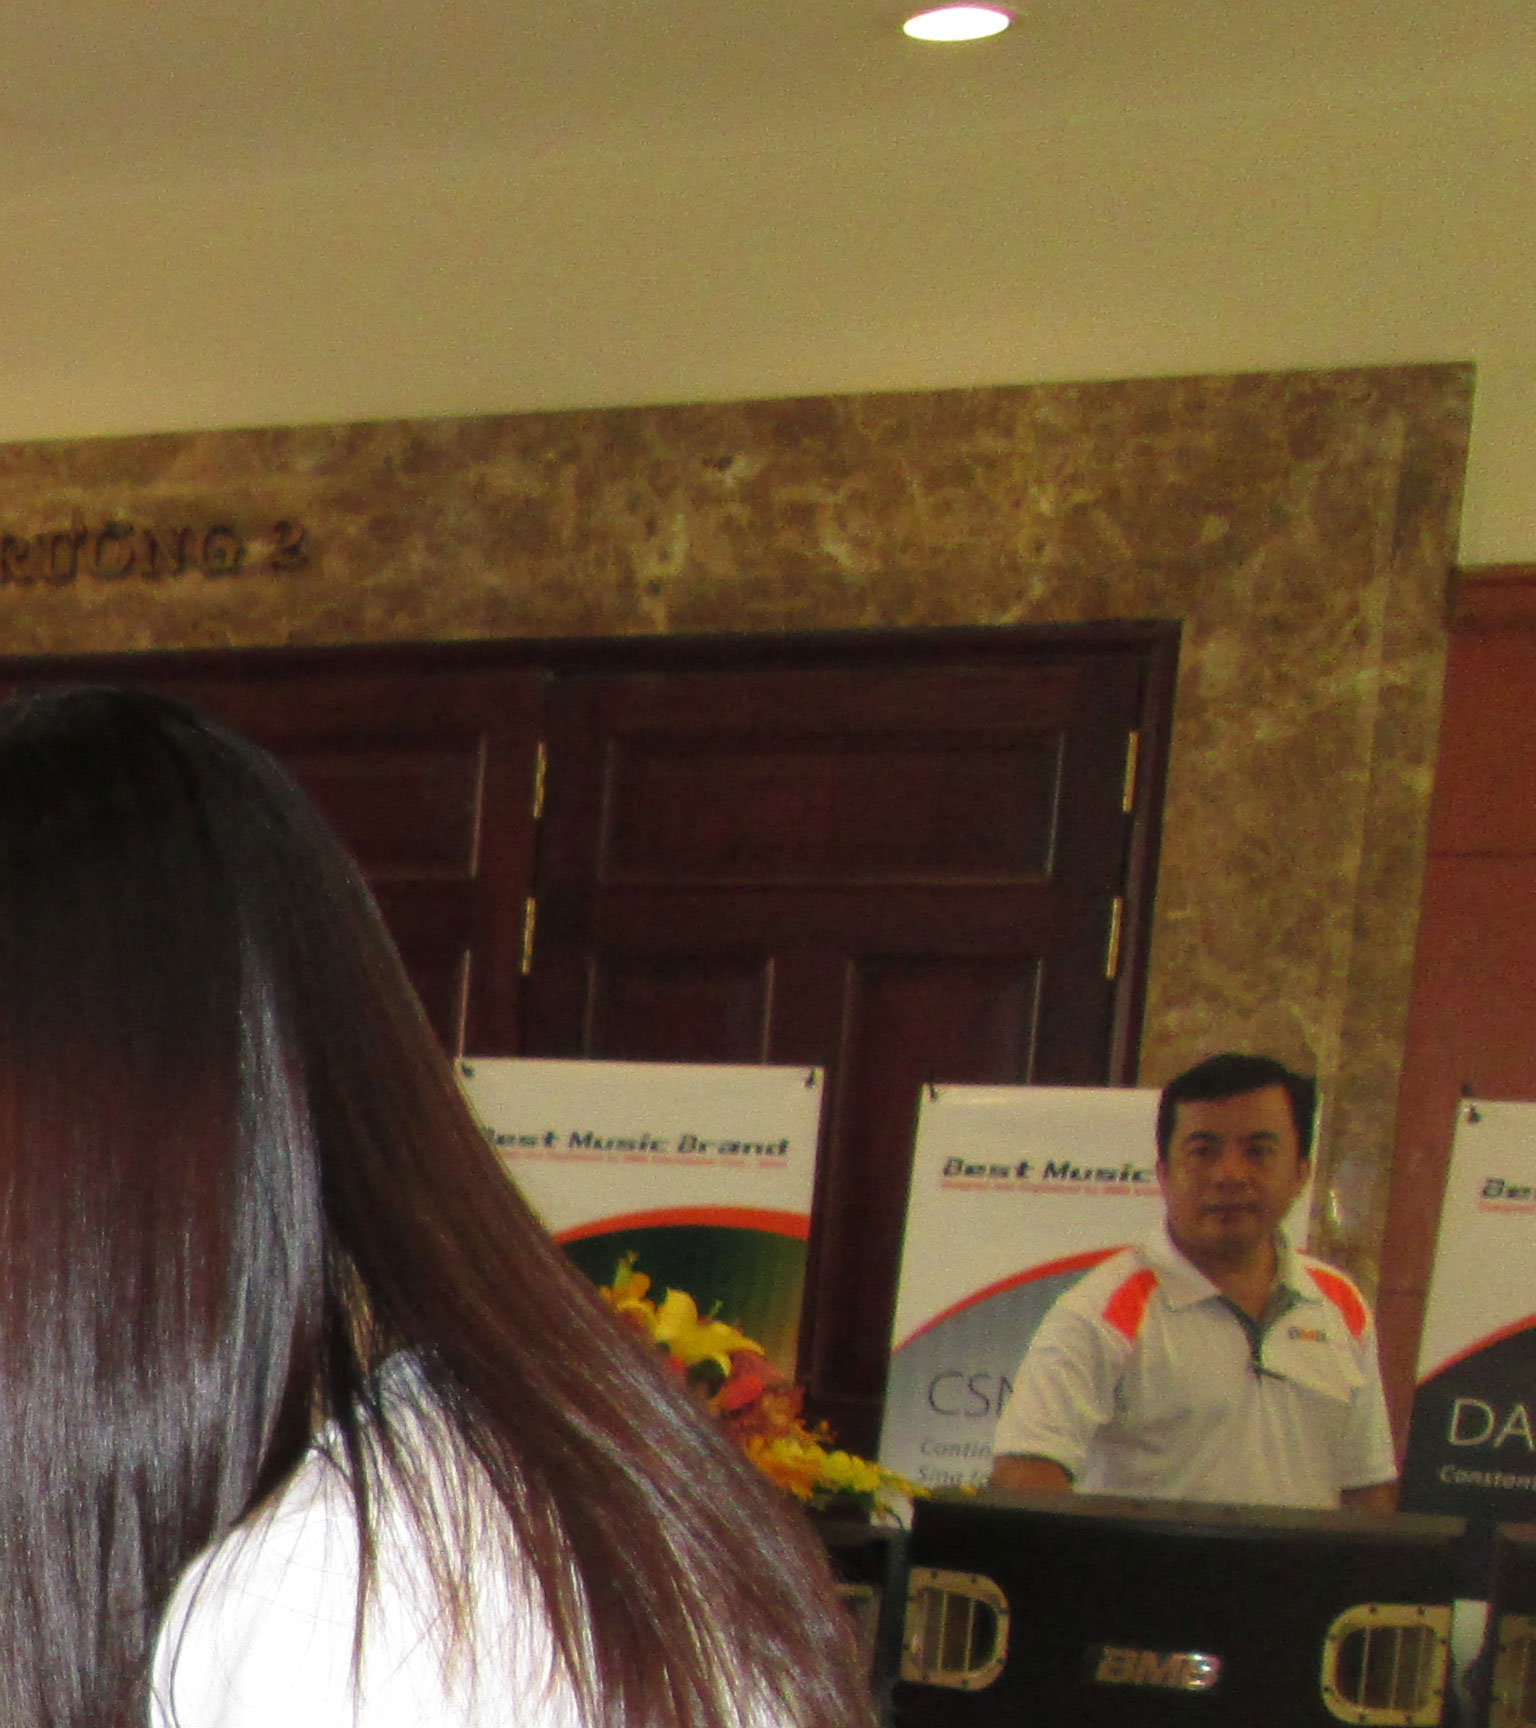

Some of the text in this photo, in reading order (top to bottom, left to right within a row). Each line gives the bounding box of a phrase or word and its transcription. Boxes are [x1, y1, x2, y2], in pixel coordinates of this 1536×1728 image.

[569, 1130, 666, 1151] Music
[678, 1133, 790, 1156] Brand
[943, 1156, 1152, 1183] Best Music
[1094, 1646, 1225, 1691] BMB
